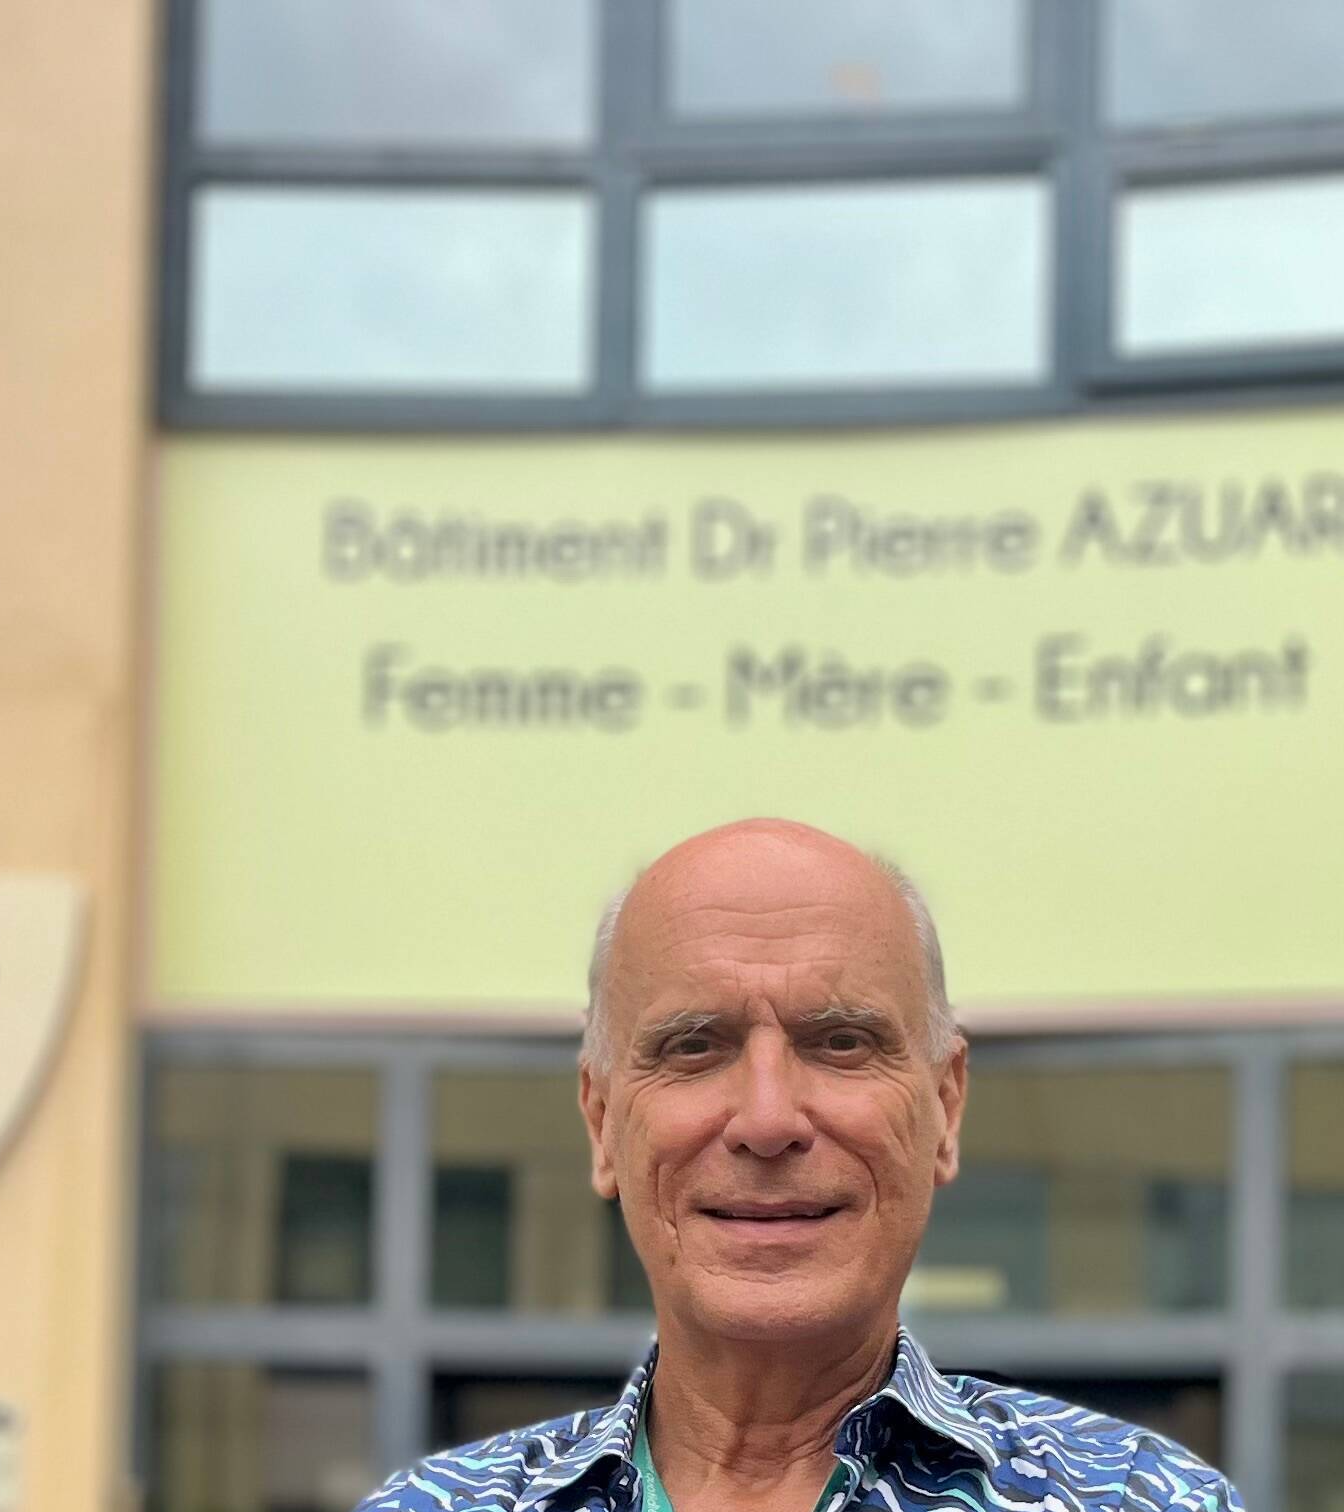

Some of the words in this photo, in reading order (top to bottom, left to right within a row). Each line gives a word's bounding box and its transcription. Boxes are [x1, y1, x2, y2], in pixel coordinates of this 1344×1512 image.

[693, 498, 776, 580] Dr
[805, 496, 1037, 575] Pierre
[362, 643, 644, 732] Femme
[725, 644, 951, 730] Mère
[1035, 634, 1308, 722] Enfant
